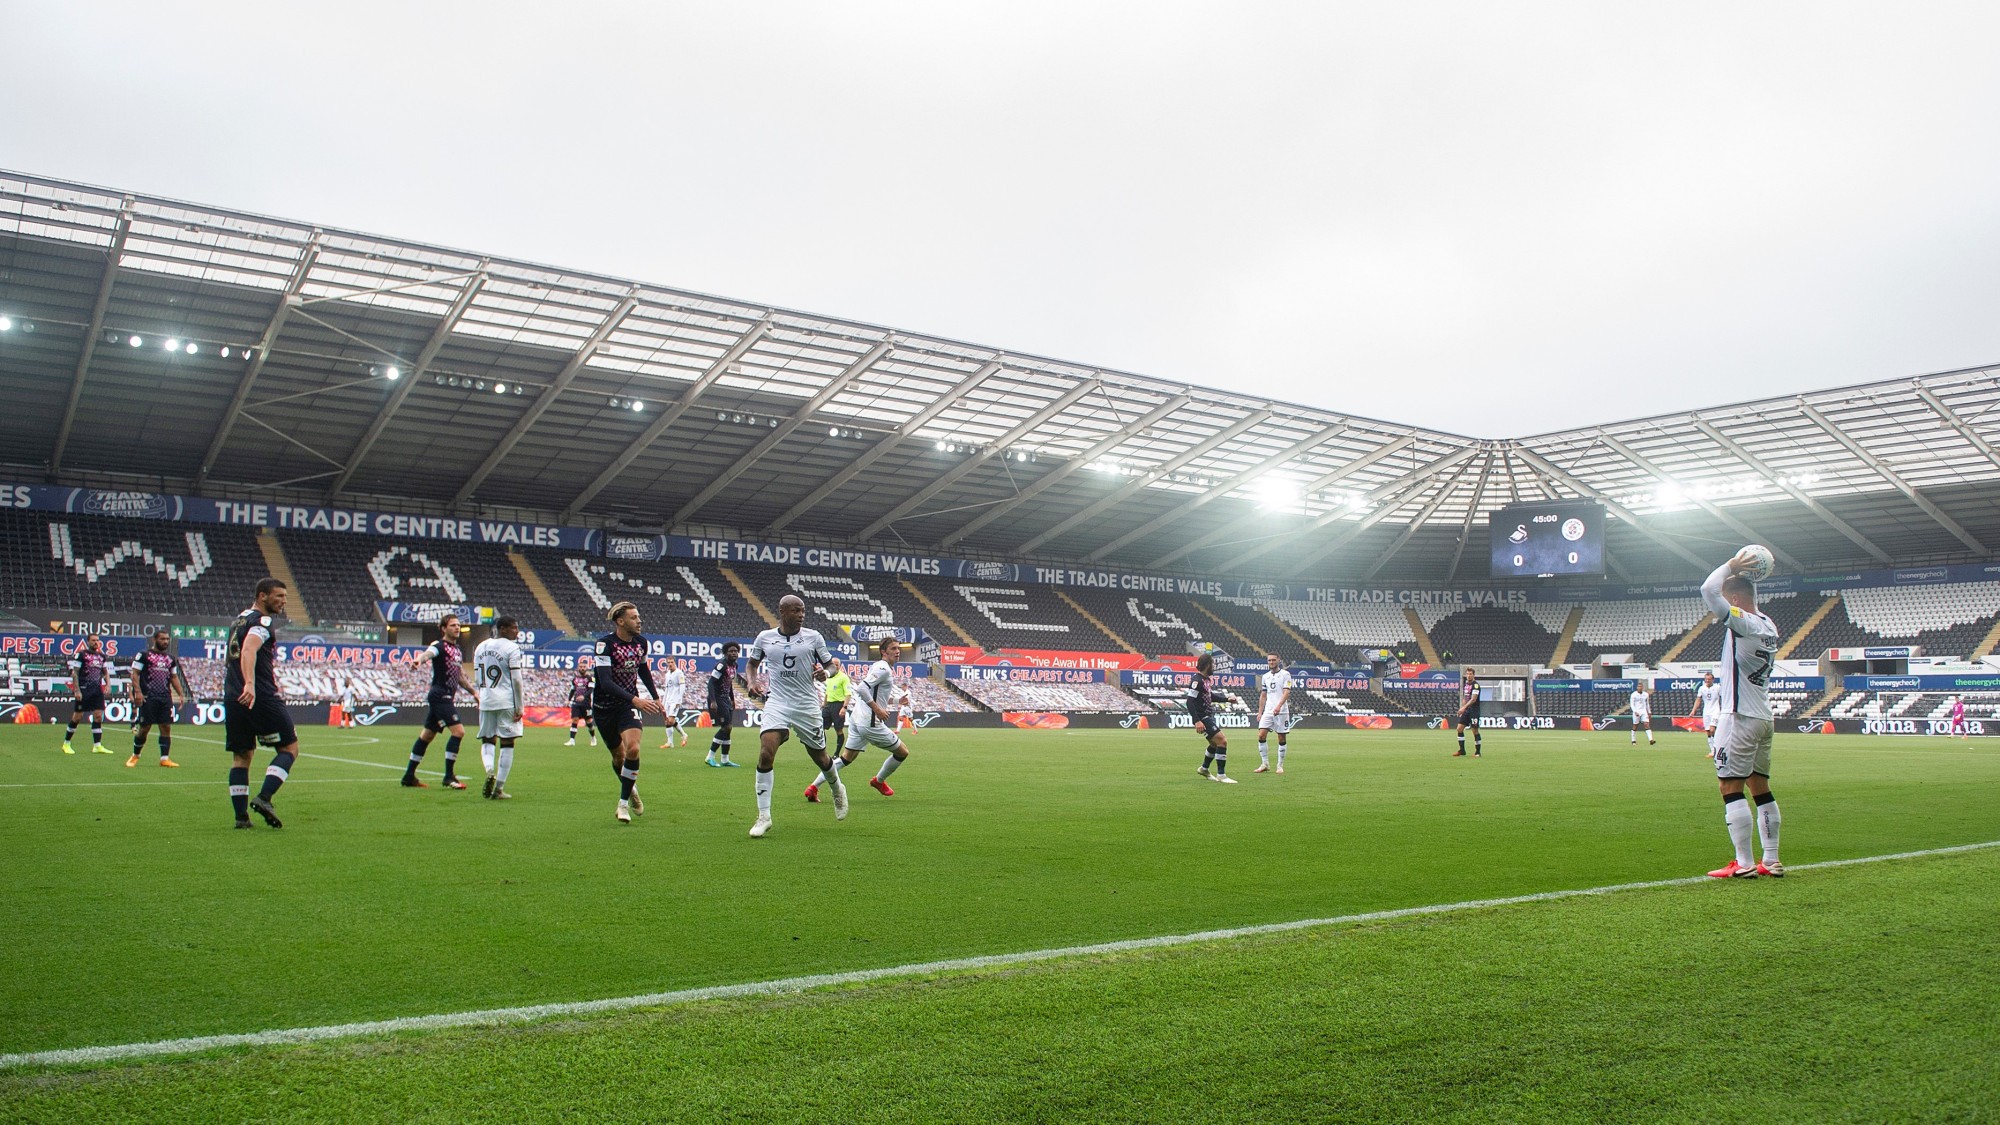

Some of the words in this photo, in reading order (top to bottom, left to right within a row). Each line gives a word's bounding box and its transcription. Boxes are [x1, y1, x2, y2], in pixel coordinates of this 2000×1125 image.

[0, 485, 31, 508] ES
[96, 491, 154, 500] TRADE
[102, 500, 150, 511] CENTRE
[215, 501, 268, 526] THE
[276, 506, 367, 533] TRADE
[375, 514, 472, 541] CENTRE
[479, 522, 561, 547] WALES
[1532, 514, 1558, 524] 45:00
[610, 537, 653, 545] TRADE
[614, 544, 649, 554] CENTRE
[690, 539, 729, 559] THE
[734, 542, 800, 565] TRADE
[805, 549, 876, 570] CENTRE
[881, 555, 940, 576] WALES
[1513, 554, 1523, 566] 0
[1568, 552, 1578, 564] 0
[976, 567, 1002, 576] CENTRE
[1896, 570, 1945, 580] theenergycheck
[1035, 567, 1064, 584] THE
[1068, 570, 1117, 587] TRADE
[1121, 575, 1174, 593] CENTRE
[1177, 579, 1223, 596] WALES
[1306, 588, 1336, 602] THE
[1340, 589, 1394, 603] TRADE
[1398, 590, 1463, 604] CENTRE
[1467, 590, 1527, 604] WALES
[1627, 586, 1648, 595] check
[1669, 585, 1688, 593] much
[67, 621, 165, 637] TRUSTPILOT
[343, 624, 384, 633] TRUSTPILOT
[517, 631, 535, 643] 99
[0, 637, 54, 655] PEST
[672, 642, 755, 659] DEPOIT
[837, 644, 857, 655] £99
[204, 645, 228, 660] TH
[291, 646, 384, 666] CHEAPEST
[388, 649, 432, 665] CAR
[1865, 648, 1908, 657] theenergycheck
[520, 655, 535, 669] HE
[539, 655, 575, 669] UK'S
[657, 659, 698, 673] CRS
[1052, 657, 1078, 669] Away
[1079, 659, 1088, 668] In
[1090, 659, 1095, 668] 1
[1096, 659, 1120, 669] Hour
[478, 663, 502, 689] 19
[892, 665, 913, 678] ARS
[960, 668, 980, 680] THE
[983, 668, 1008, 681] UK'S
[1009, 669, 1062, 682] CHEAPEST
[1064, 671, 1093, 683] CARS
[1133, 672, 1150, 684] THE
[1152, 673, 1173, 684] UK'S
[1174, 674, 1219, 687] CHEST
[1221, 675, 1246, 687] CARS
[1291, 679, 1305, 689] K'S
[1306, 678, 1346, 689] CHEAPEST
[1346, 679, 1369, 690] CARS
[1671, 679, 1696, 690] check
[1785, 681, 1805, 689] save
[1870, 678, 1918, 687] theenergycheck
[1955, 678, 2000, 687] theenergych
[631, 708, 643, 720] 1
[1479, 717, 1508, 728] ma
